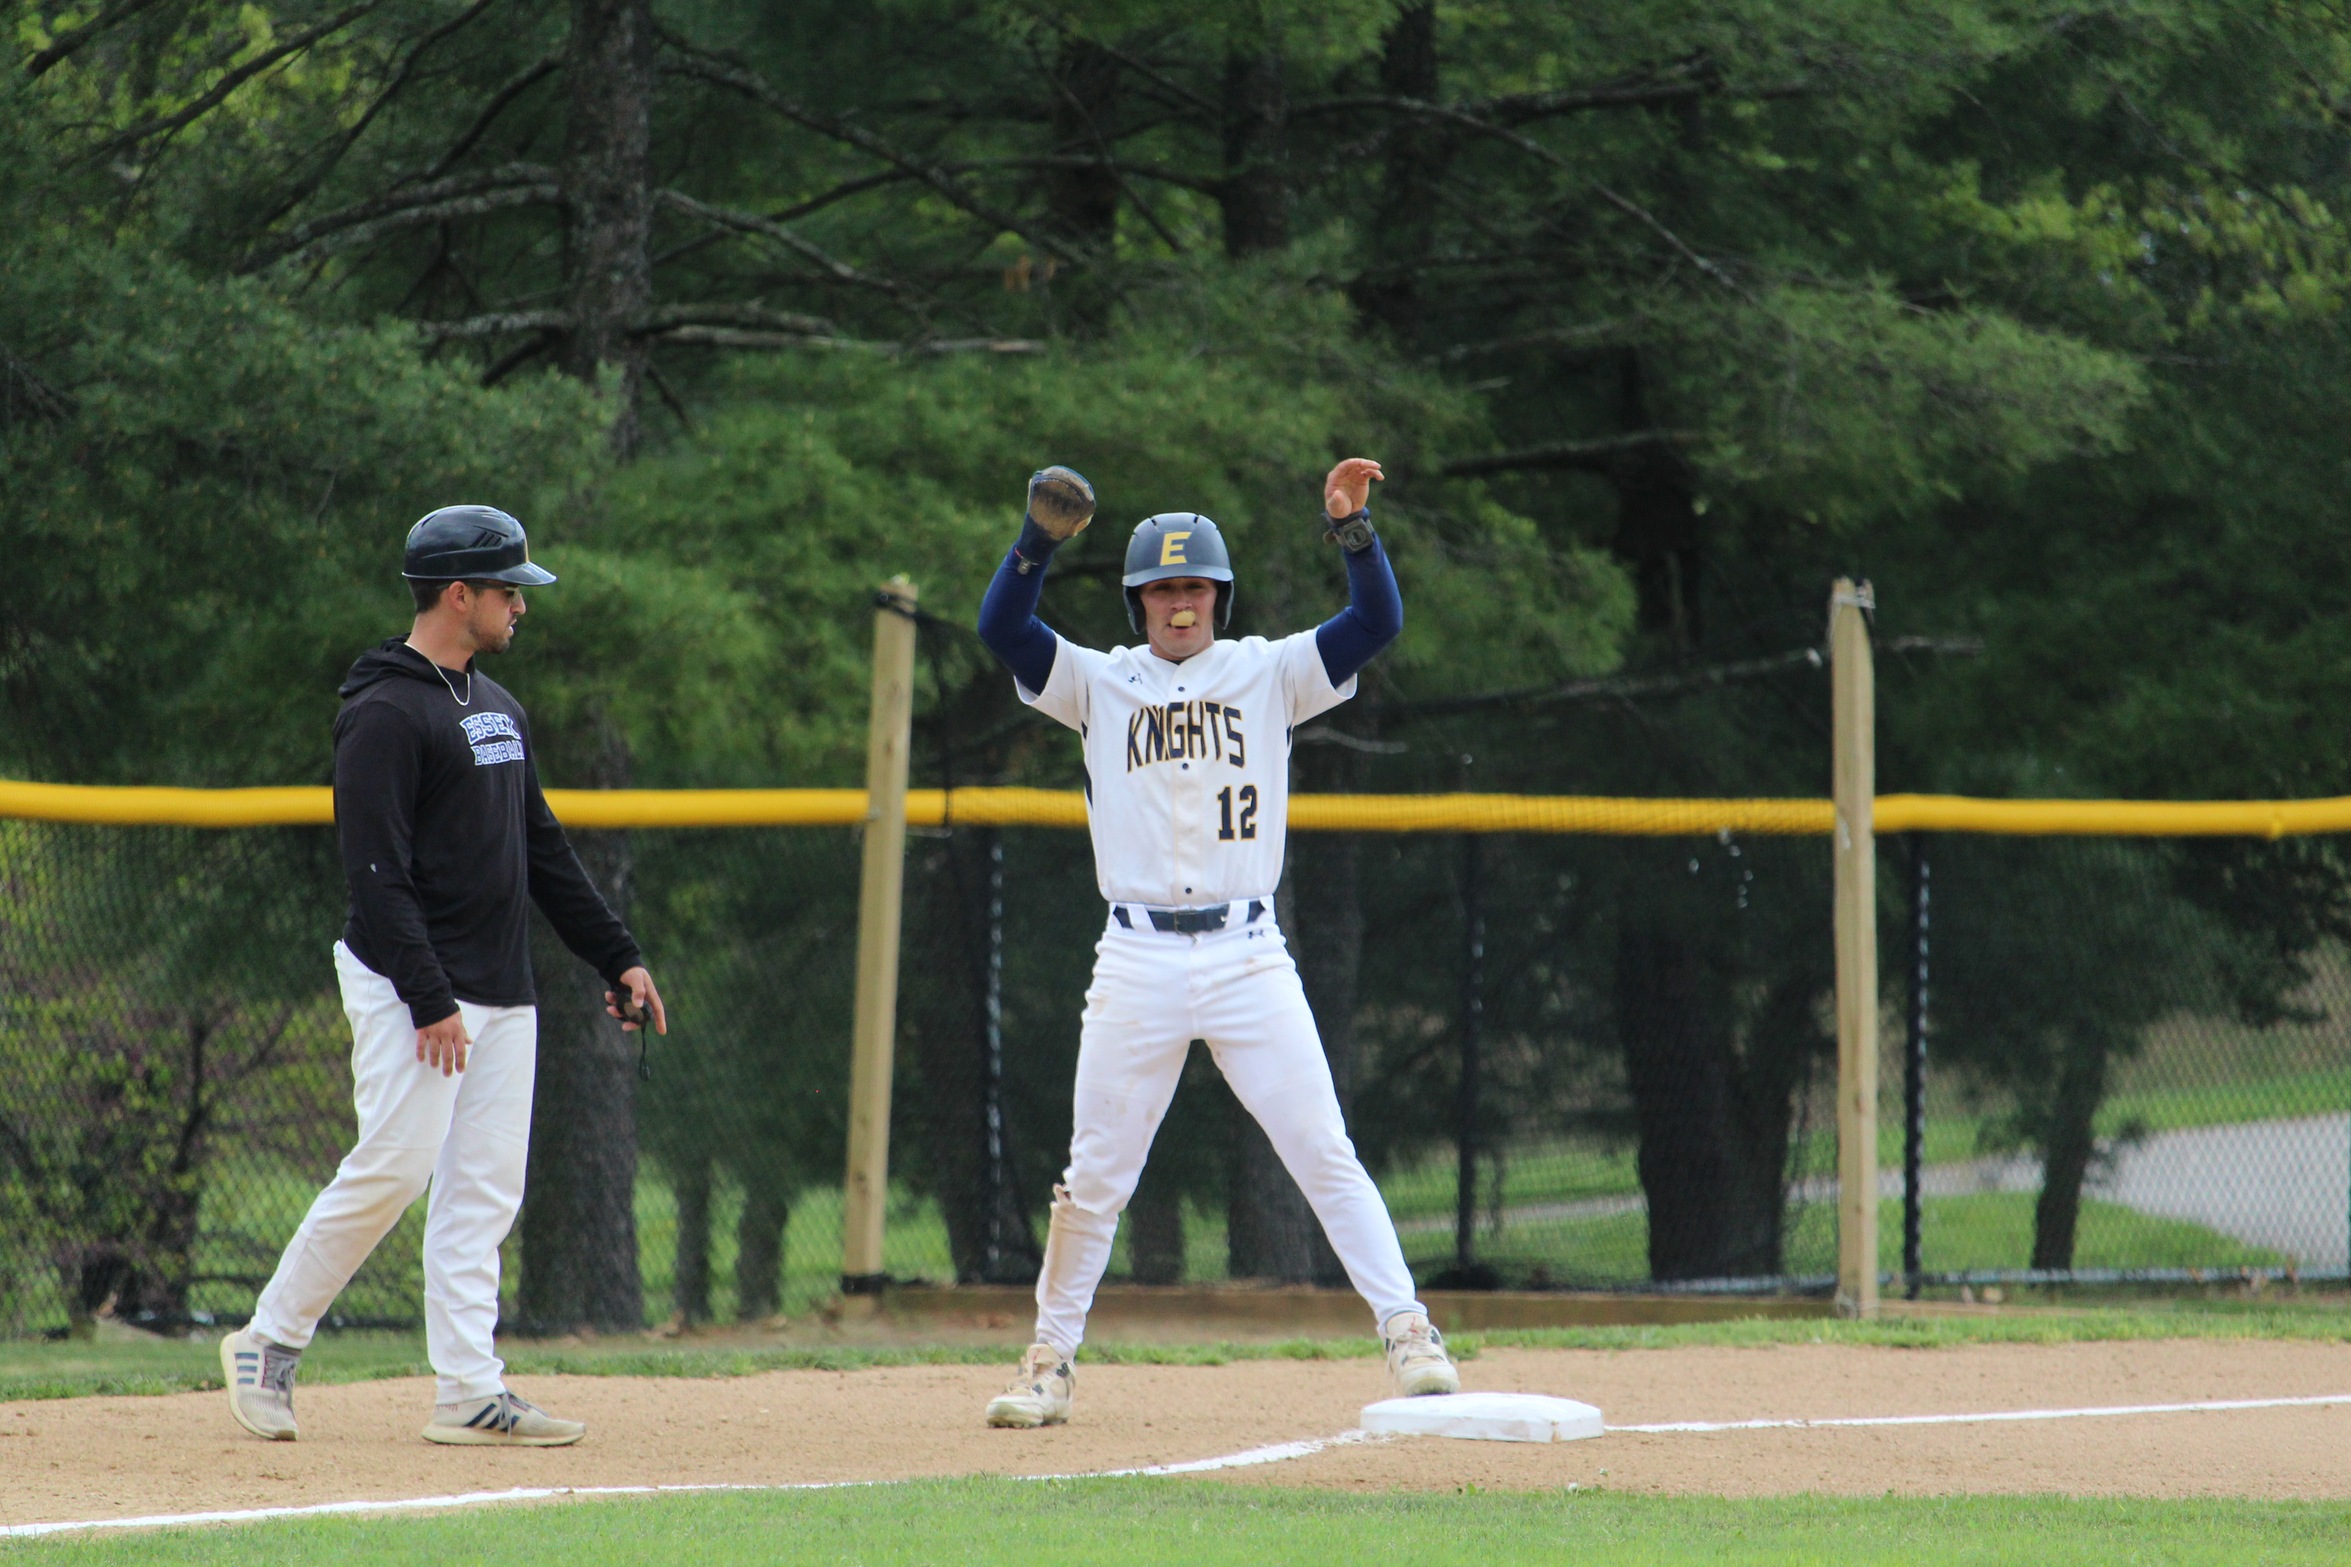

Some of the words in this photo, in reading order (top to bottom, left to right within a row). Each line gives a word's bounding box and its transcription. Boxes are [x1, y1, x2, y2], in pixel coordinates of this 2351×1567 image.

[1160, 532, 1192, 566] E
[470, 740, 525, 765] BASEBAL
[1217, 784, 1257, 841] 12
